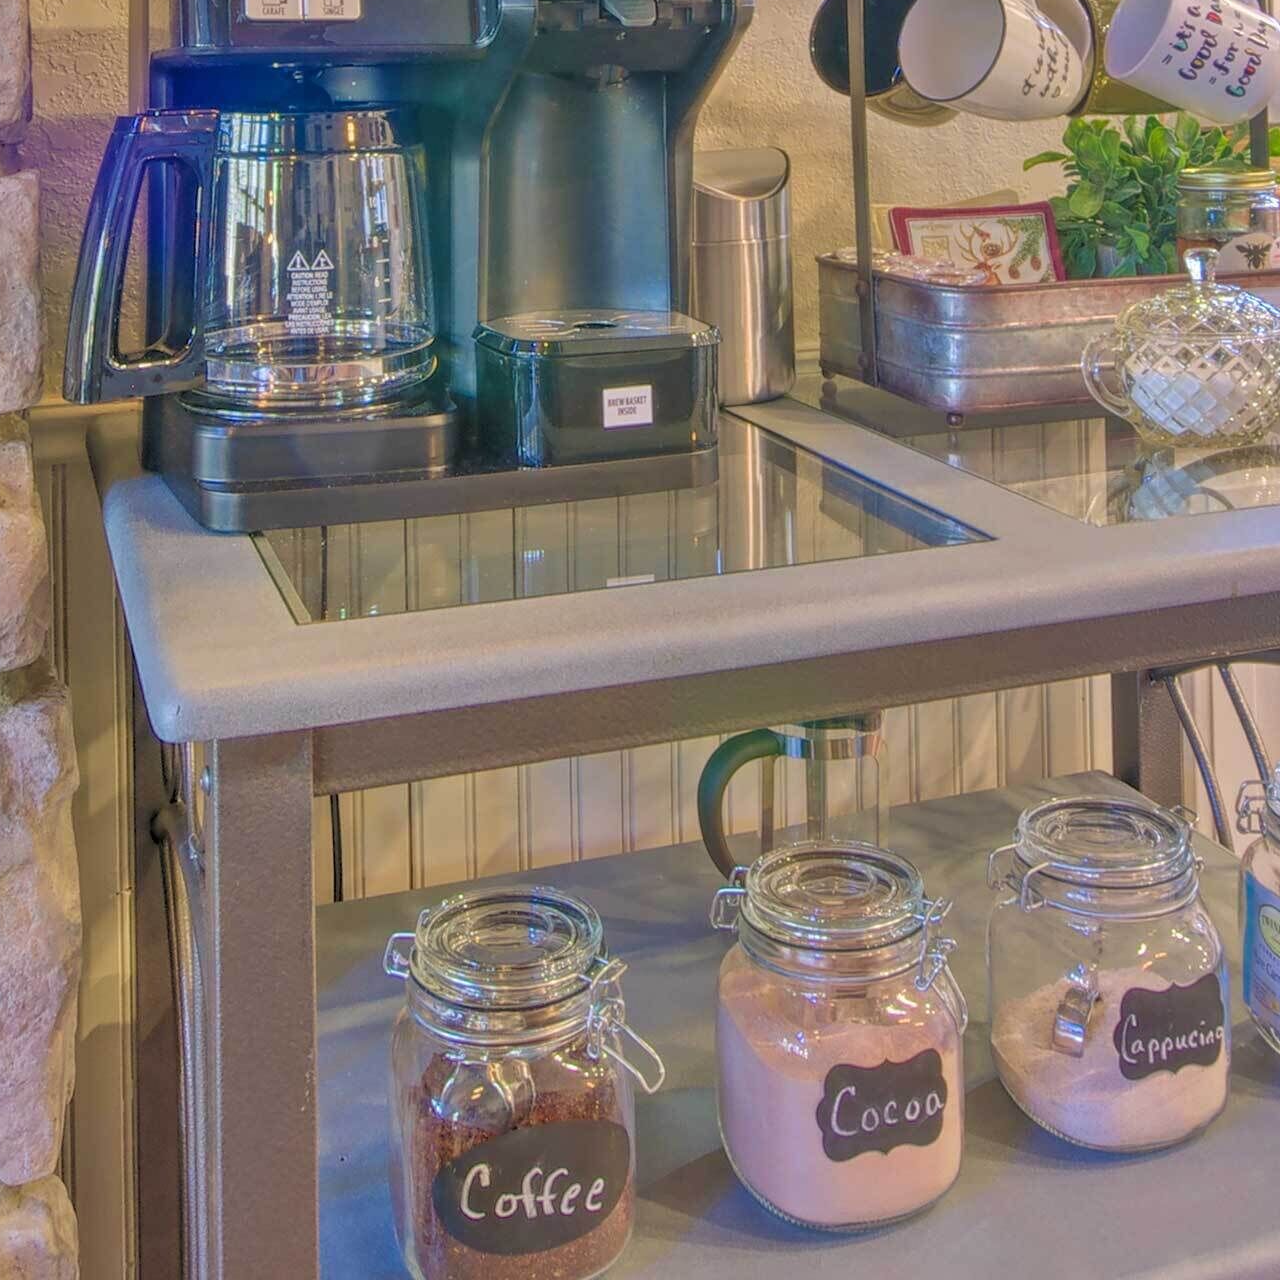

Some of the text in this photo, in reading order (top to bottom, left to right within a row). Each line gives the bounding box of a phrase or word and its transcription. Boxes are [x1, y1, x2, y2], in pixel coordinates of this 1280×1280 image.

[262, 7, 285, 15] CARAFE
[625, 395, 647, 405] BASKET
[831, 1086, 944, 1136] Cocoa
[460, 1163, 605, 1219] Coffee
